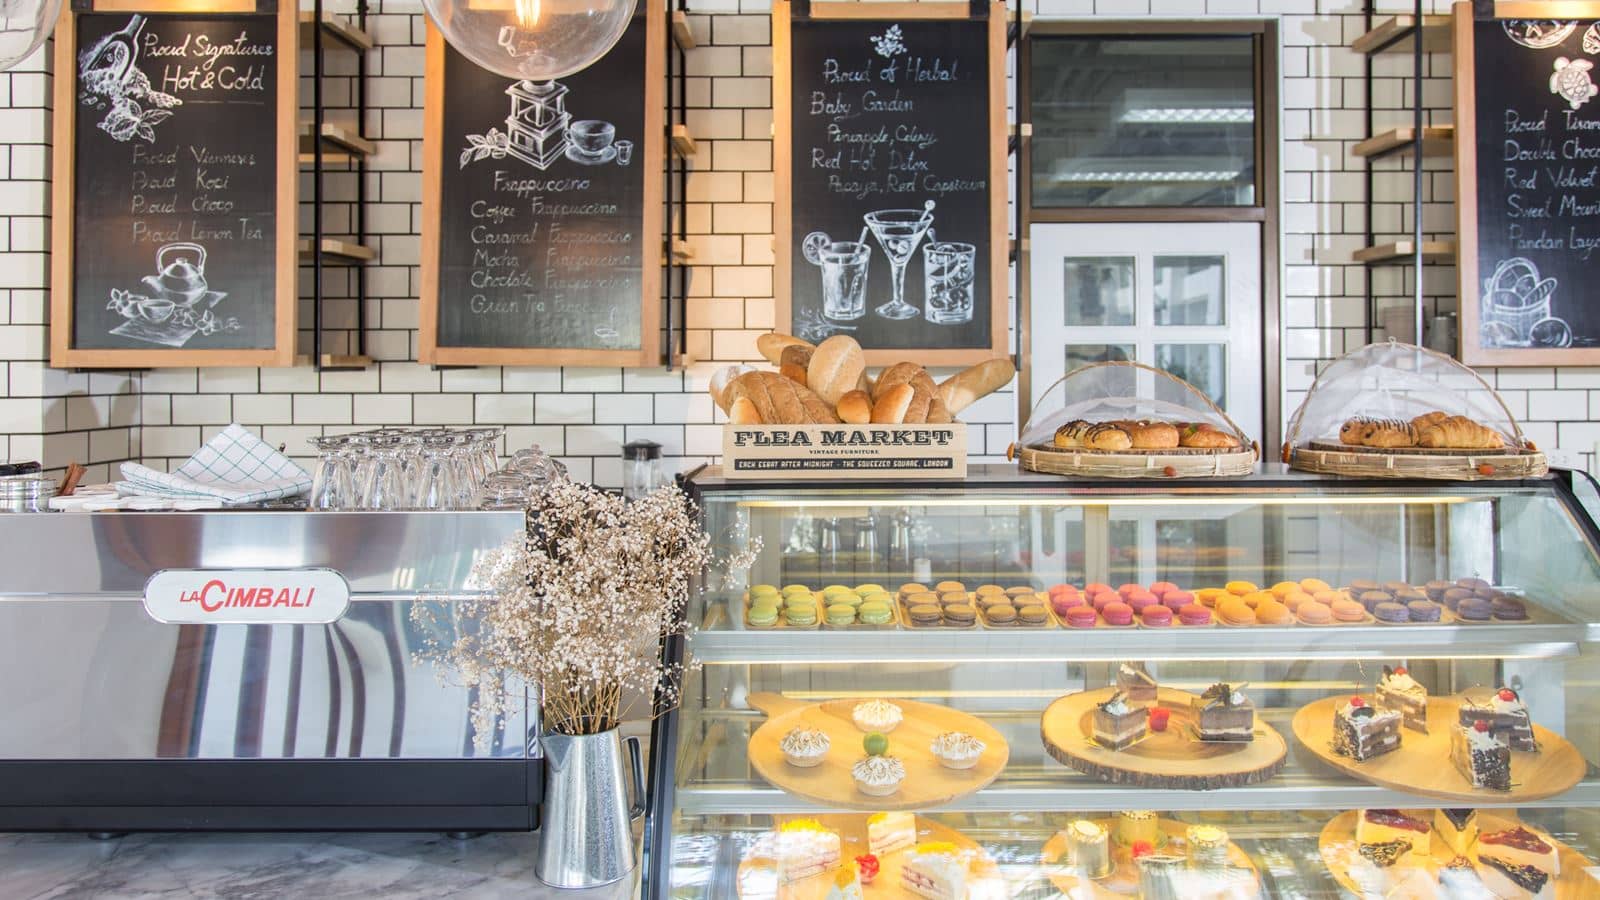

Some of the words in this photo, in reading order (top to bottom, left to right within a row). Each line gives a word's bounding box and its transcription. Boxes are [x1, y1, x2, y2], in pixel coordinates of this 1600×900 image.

[143, 33, 191, 57] Proud
[193, 31, 273, 70] Signatures
[217, 64, 265, 91] Cold
[823, 58, 871, 83] Proud
[880, 58, 899, 82] of
[907, 56, 958, 82] Herbal
[810, 91, 860, 121] Baby
[862, 89, 913, 113] Garden
[1504, 109, 1548, 132] Proud
[811, 148, 842, 169] Red
[850, 149, 876, 171] Hot
[888, 151, 929, 171] Detox
[1503, 138, 1557, 161] Double
[493, 170, 591, 198] Frappuccino
[886, 172, 918, 193] Red
[1504, 168, 1538, 189] Red
[1547, 166, 1598, 187] Velvet
[470, 200, 516, 224] Coffee
[1507, 194, 1553, 218] Sweet
[238, 217, 263, 241] Tea
[1509, 223, 1563, 249] Pandan
[472, 248, 520, 267] Mocha
[470, 294, 519, 314] Green
[734, 430, 813, 447] FLEA
[820, 430, 954, 447] MARKET
[857, 460, 891, 468] SQUEEZED
[923, 460, 949, 468] LONDON
[179, 591, 201, 602] LA
[199, 579, 316, 612] CIMBALI
